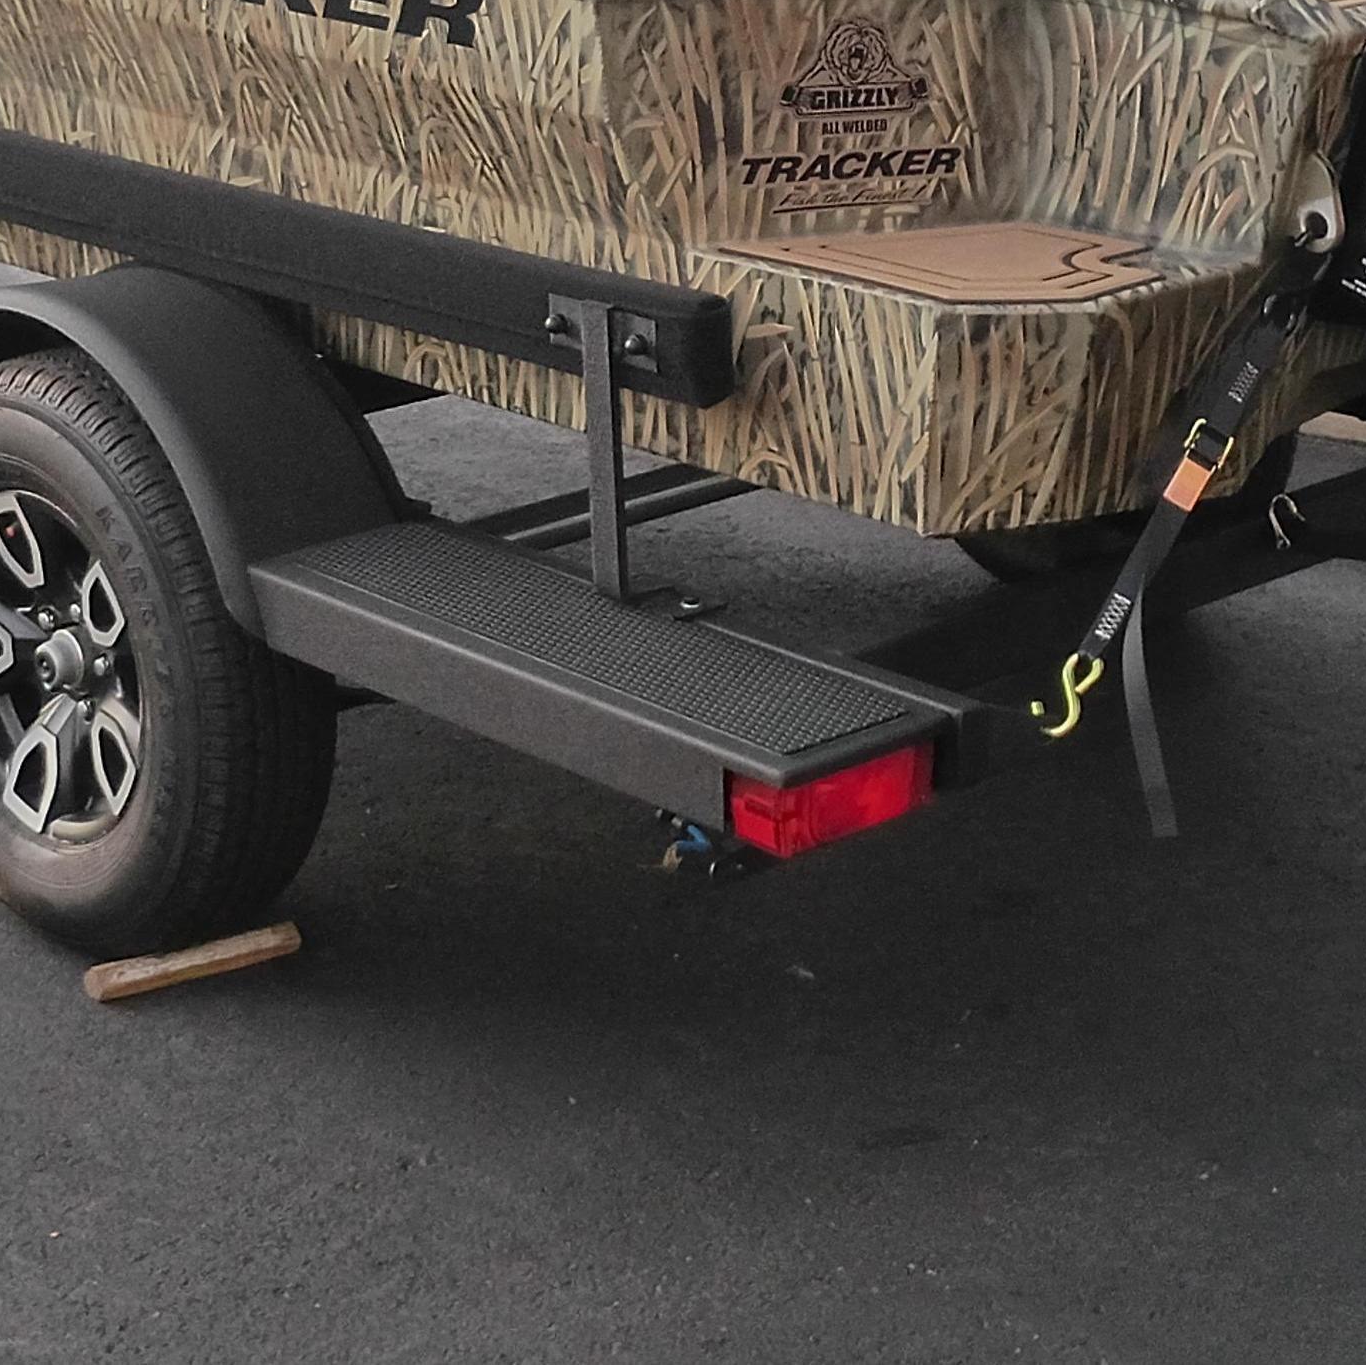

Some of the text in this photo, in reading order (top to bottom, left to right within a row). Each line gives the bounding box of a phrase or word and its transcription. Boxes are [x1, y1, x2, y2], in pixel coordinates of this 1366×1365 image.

[809, 86, 899, 111] GRIZZLY
[821, 118, 888, 135] ALL WELDED
[740, 146, 962, 186] TRACKER
